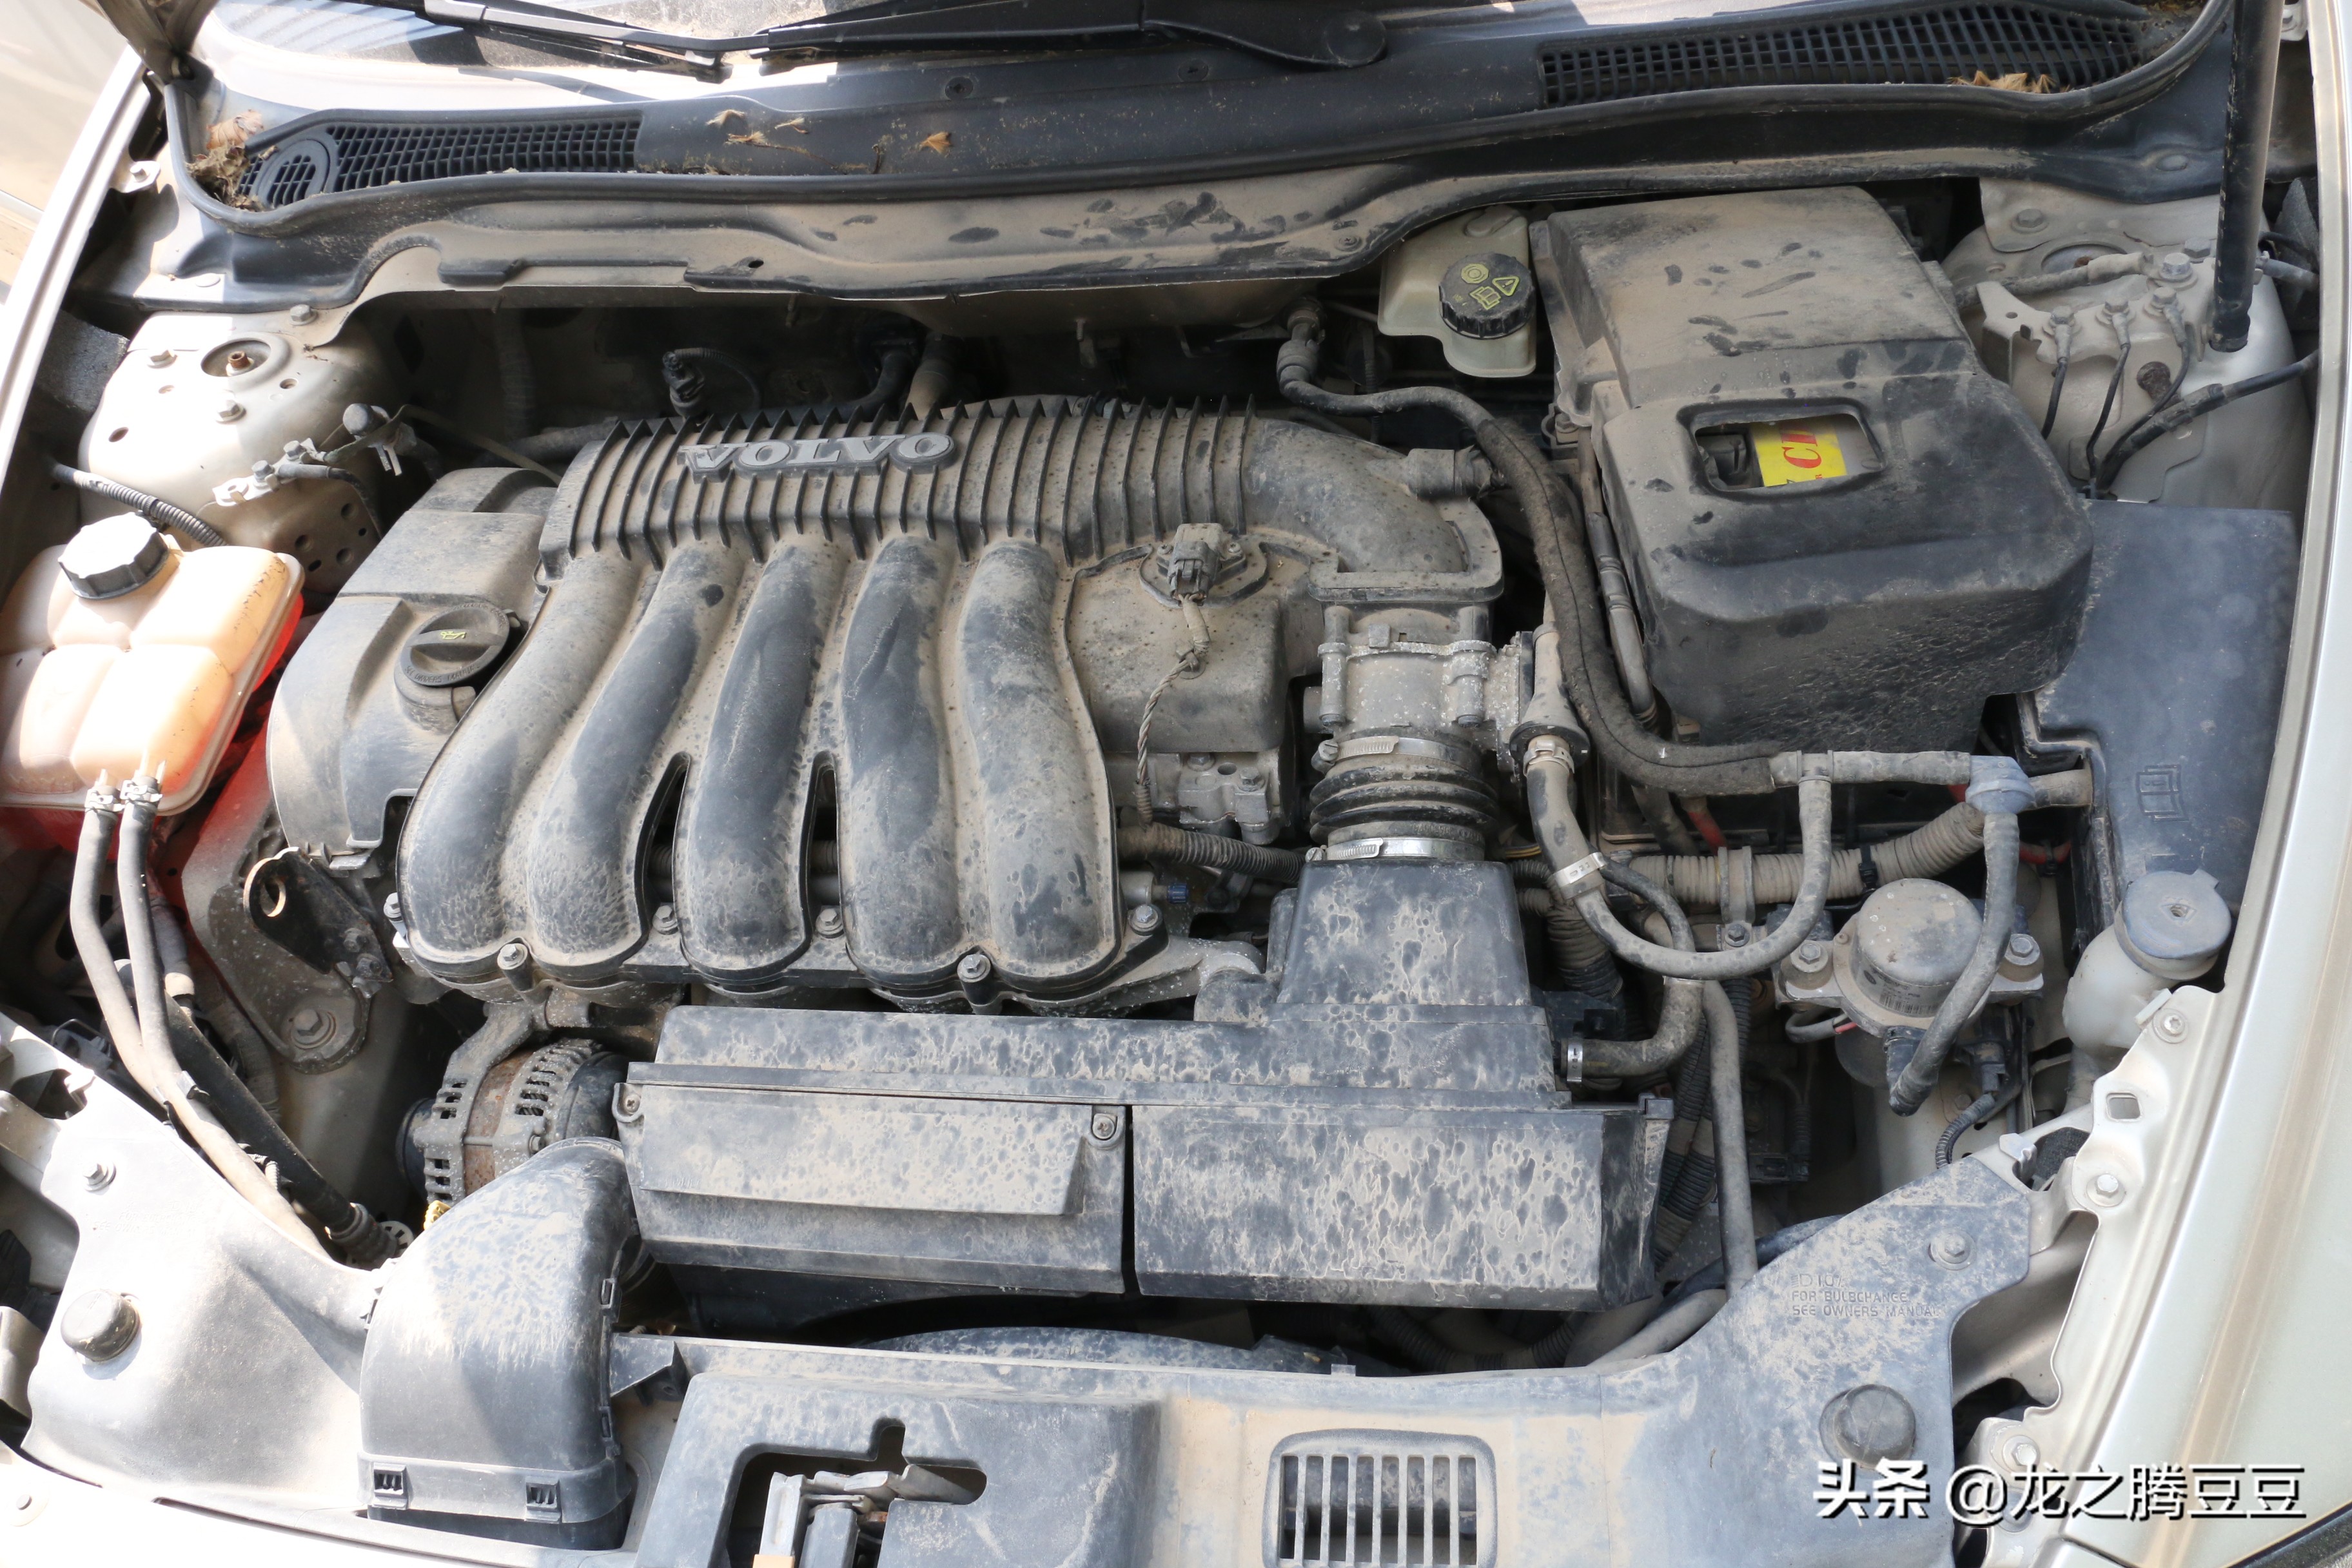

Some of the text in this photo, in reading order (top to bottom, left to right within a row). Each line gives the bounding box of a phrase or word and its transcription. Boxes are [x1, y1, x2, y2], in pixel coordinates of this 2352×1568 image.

[679, 433, 953, 471] VOLVO
[1792, 1290, 1817, 1302] FOR
[1792, 1305, 1816, 1316] SEE
[1823, 1305, 1878, 1317] OWNERS
